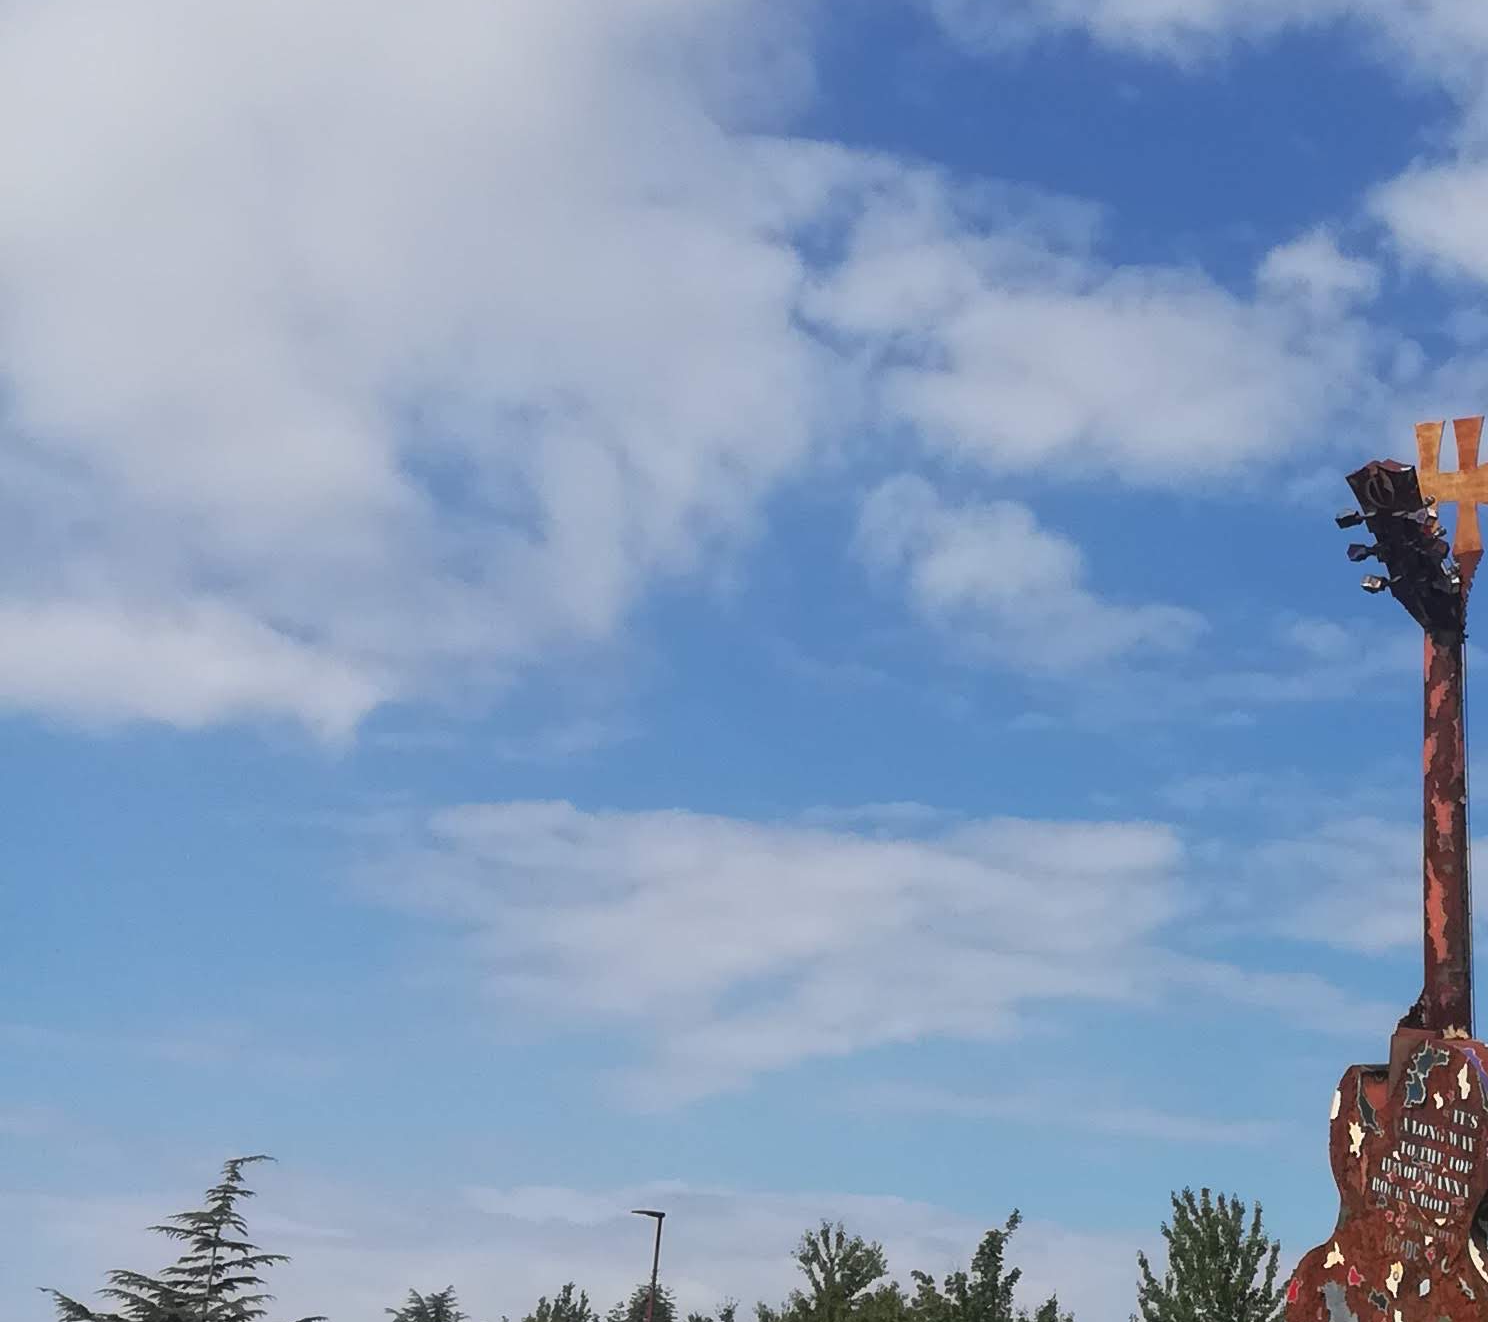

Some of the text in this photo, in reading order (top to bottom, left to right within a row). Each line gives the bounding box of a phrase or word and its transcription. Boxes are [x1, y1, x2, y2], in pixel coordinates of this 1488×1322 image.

[1412, 1120, 1445, 1143] LONG
[1448, 1130, 1477, 1152] WAY
[1400, 1140, 1474, 1174] TO THE TOP
[1371, 1176, 1404, 1200] ROCK
[1423, 1170, 1470, 1198] WANNA
